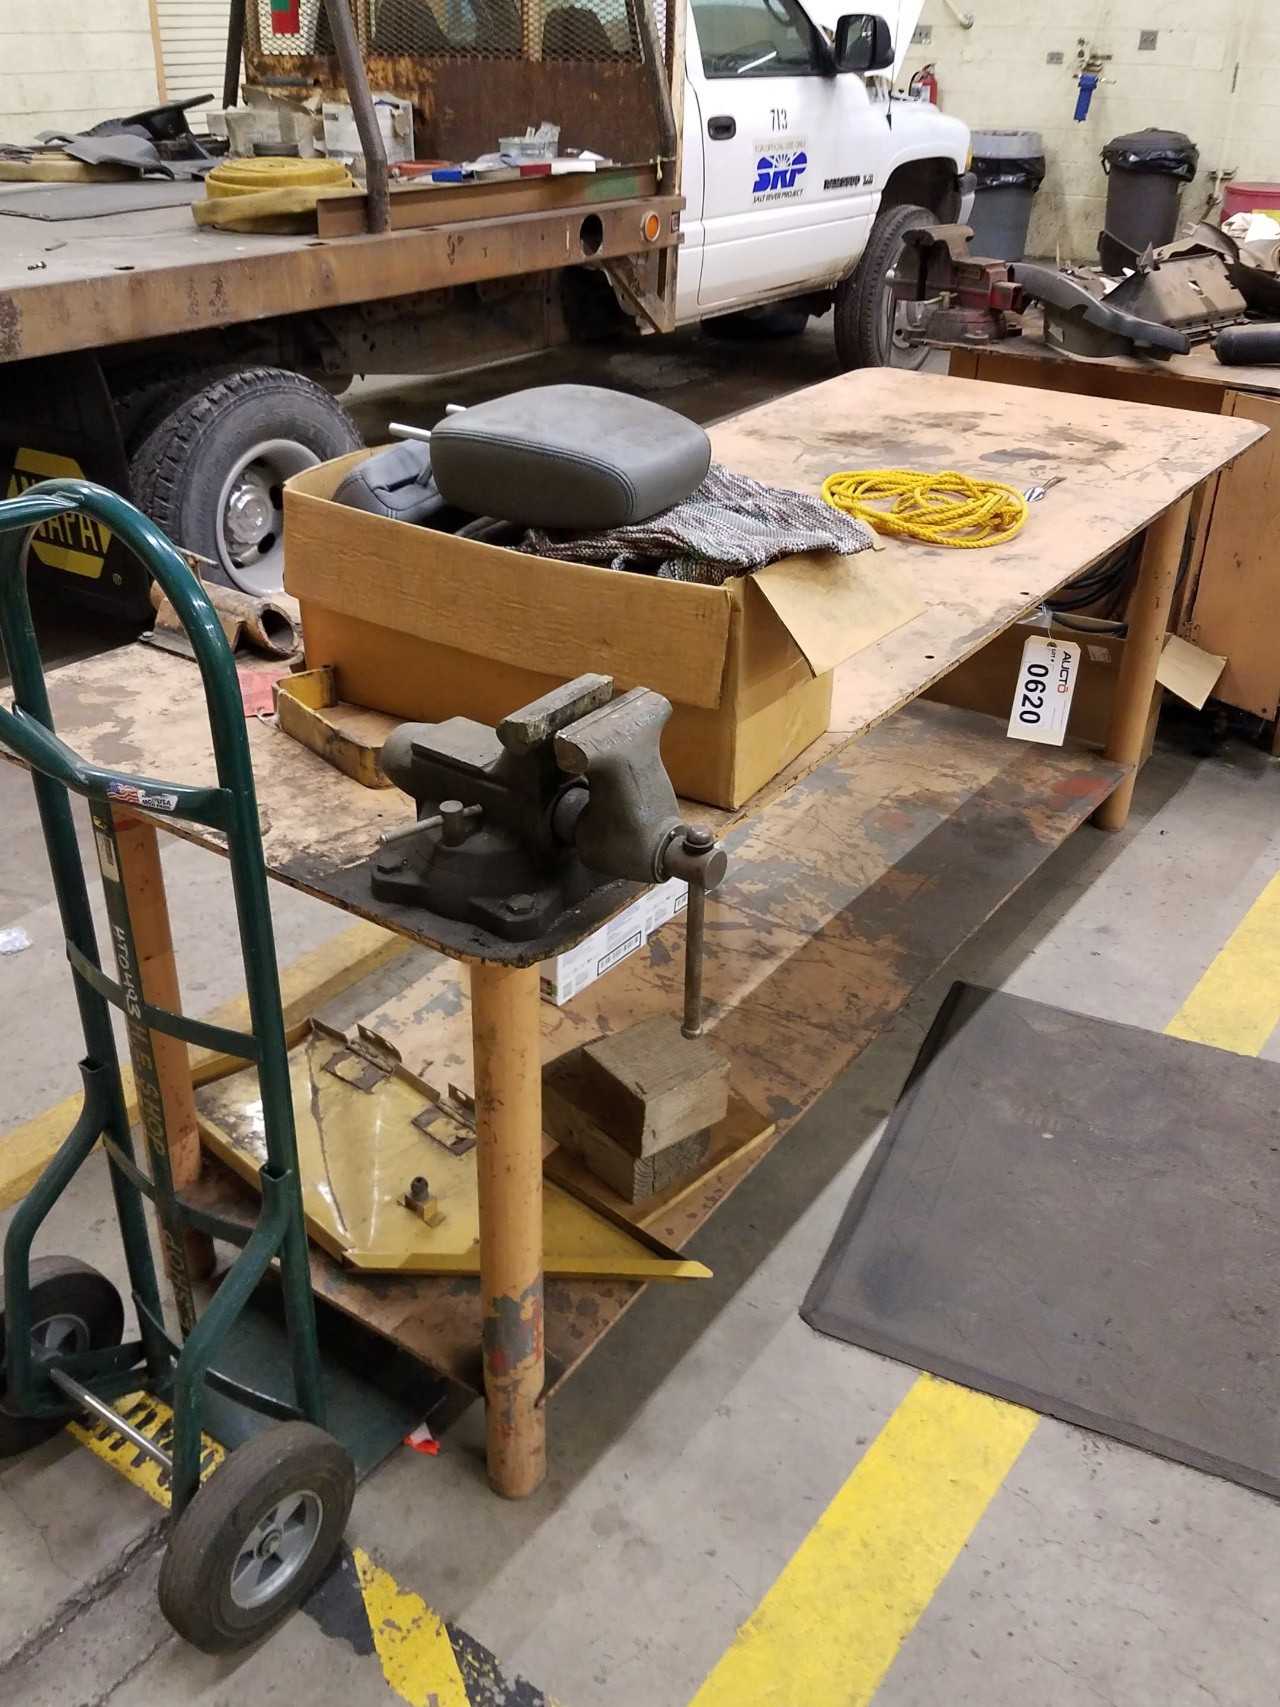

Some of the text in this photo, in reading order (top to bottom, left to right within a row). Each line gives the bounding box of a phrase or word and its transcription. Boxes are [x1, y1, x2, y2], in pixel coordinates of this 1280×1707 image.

[770, 108, 788, 131] 713
[752, 152, 808, 193] SRP
[781, 189, 803, 200] PROJECT
[1019, 663, 1049, 724] 0620
